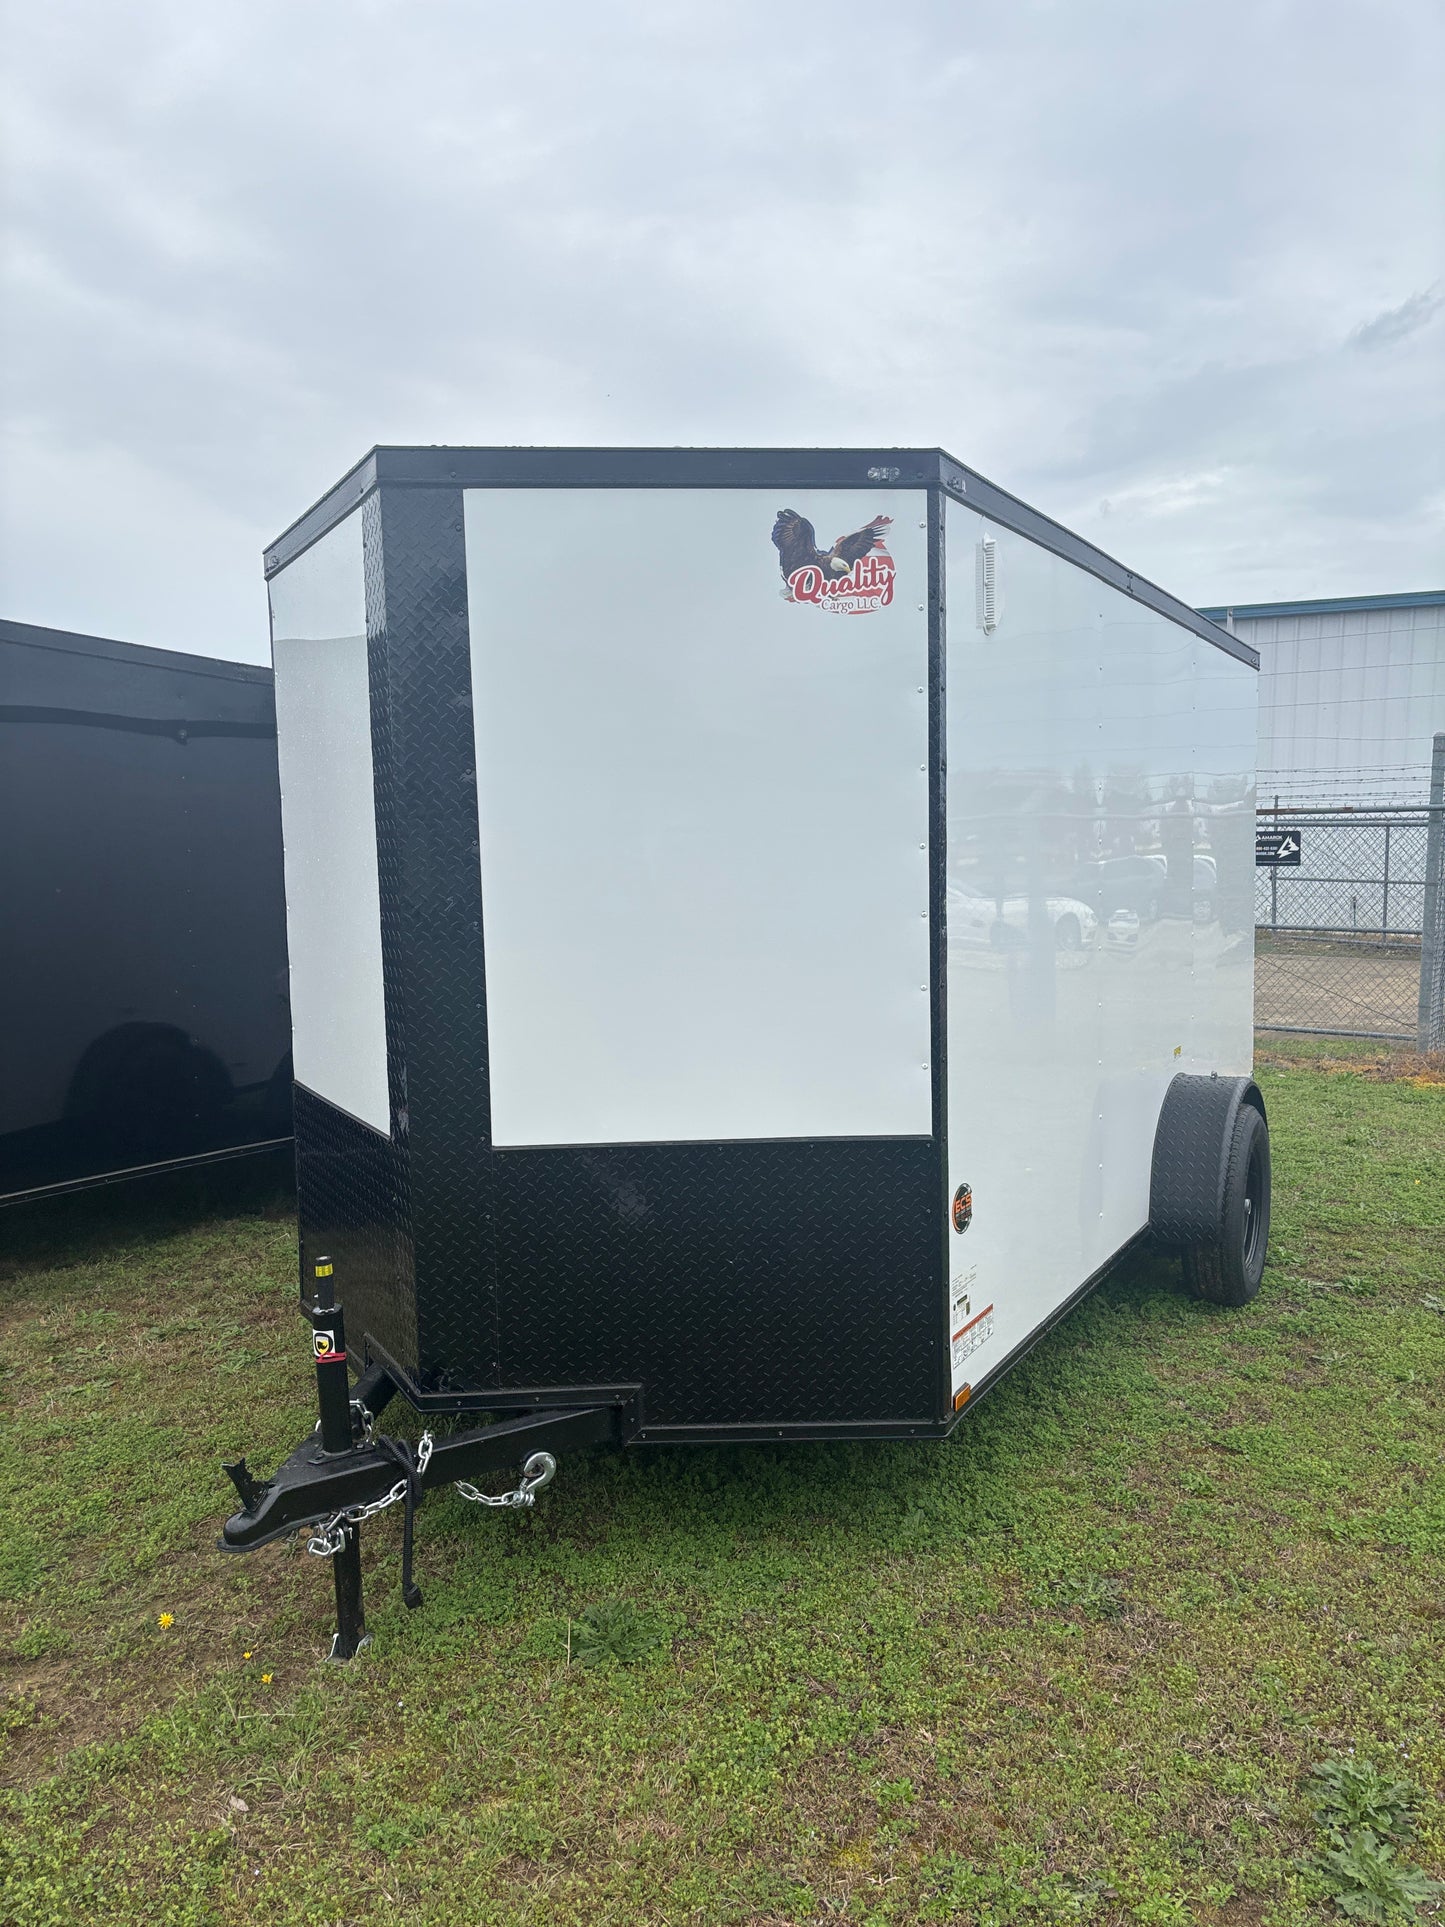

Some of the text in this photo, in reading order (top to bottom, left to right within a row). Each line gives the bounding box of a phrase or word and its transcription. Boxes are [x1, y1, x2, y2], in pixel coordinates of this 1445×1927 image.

[789, 558, 897, 606] Quality
[821, 598, 879, 614] Cargo LLC
[955, 1193, 972, 1214] ECS
